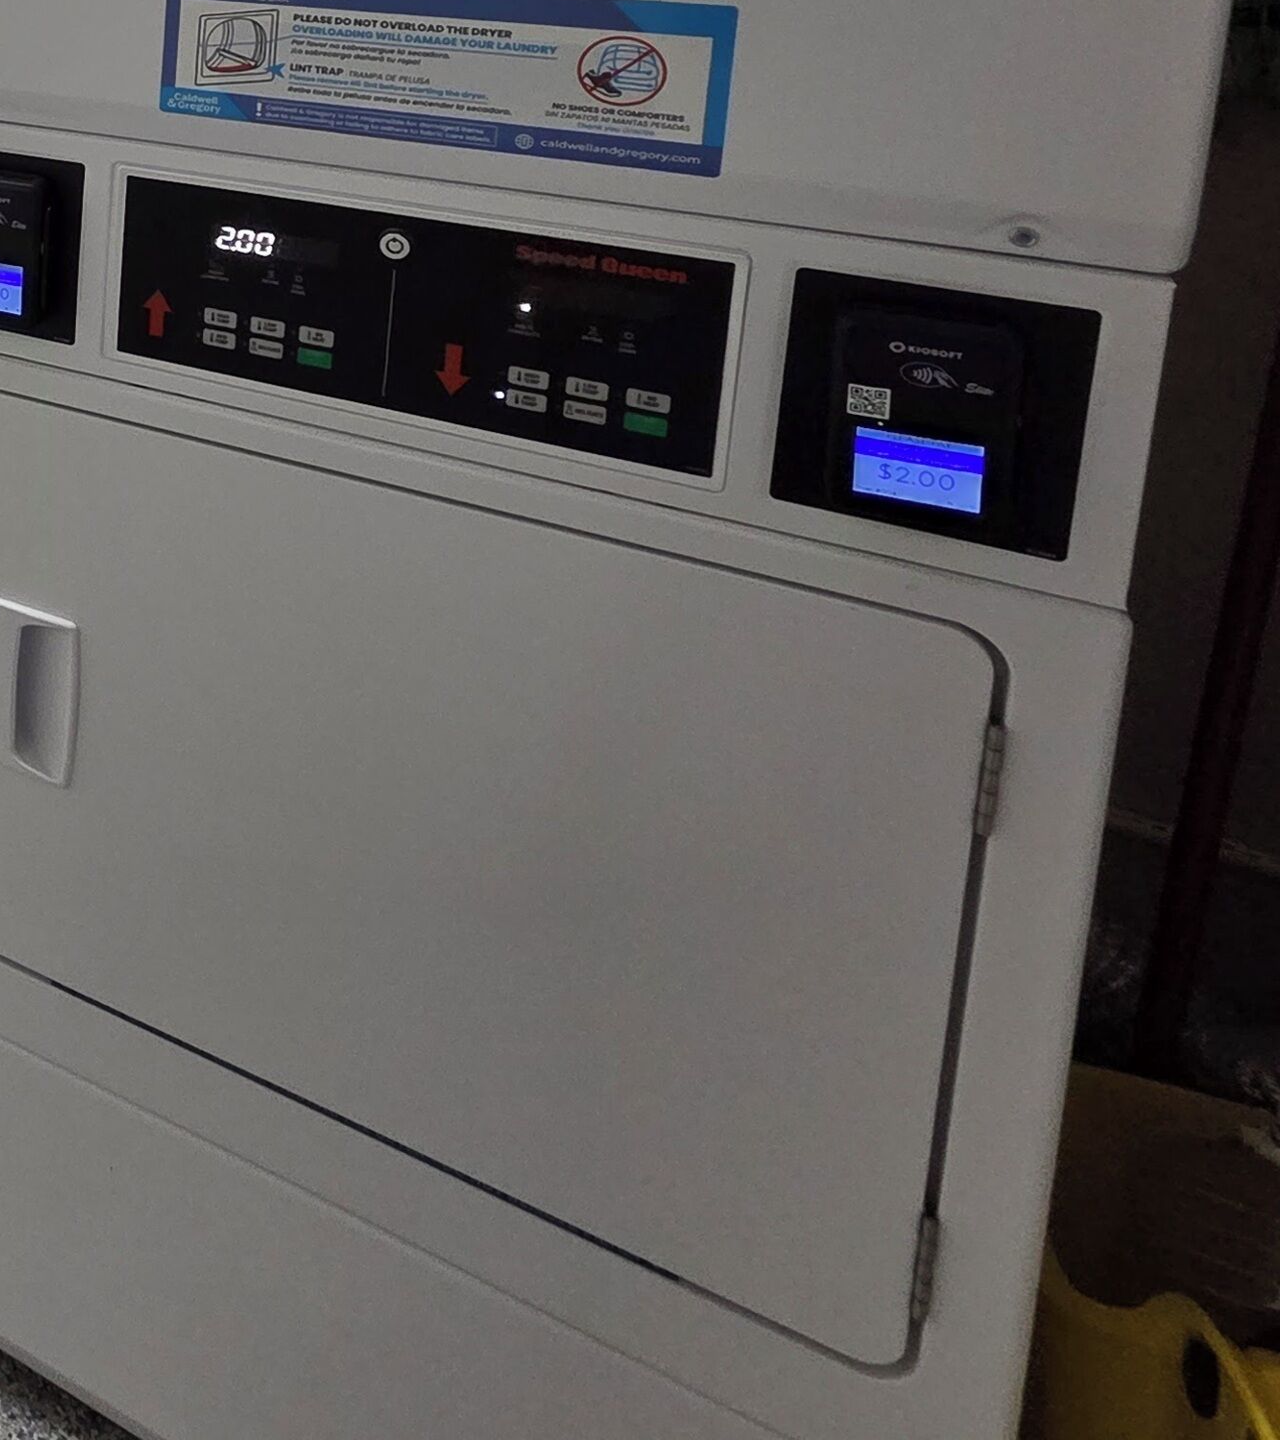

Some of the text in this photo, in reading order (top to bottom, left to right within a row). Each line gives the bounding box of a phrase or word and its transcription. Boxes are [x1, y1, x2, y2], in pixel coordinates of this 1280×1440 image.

[293, 13, 512, 38] PLEASE DO NOT OVERLOAD THE DRYER
[292, 24, 558, 55] OVERLOADING WILL DAMAGE YOUR LAUNDRY
[289, 63, 430, 85] LINT TRAP TRAMPA DE PELUSA
[167, 99, 221, 114] &Gregory
[174, 91, 218, 105] Caldwell
[552, 102, 685, 122] NO SHOES OR COMFORTERS
[560, 112, 598, 122] ZAPATOS
[612, 118, 648, 127] MANTAS
[650, 121, 690, 132] PESADAS
[540, 139, 701, 165] caldwellandgregory.com
[515, 244, 688, 284] Speed Queen
[907, 345, 963, 360] KIOSOFT
[878, 463, 955, 491] $2.00
